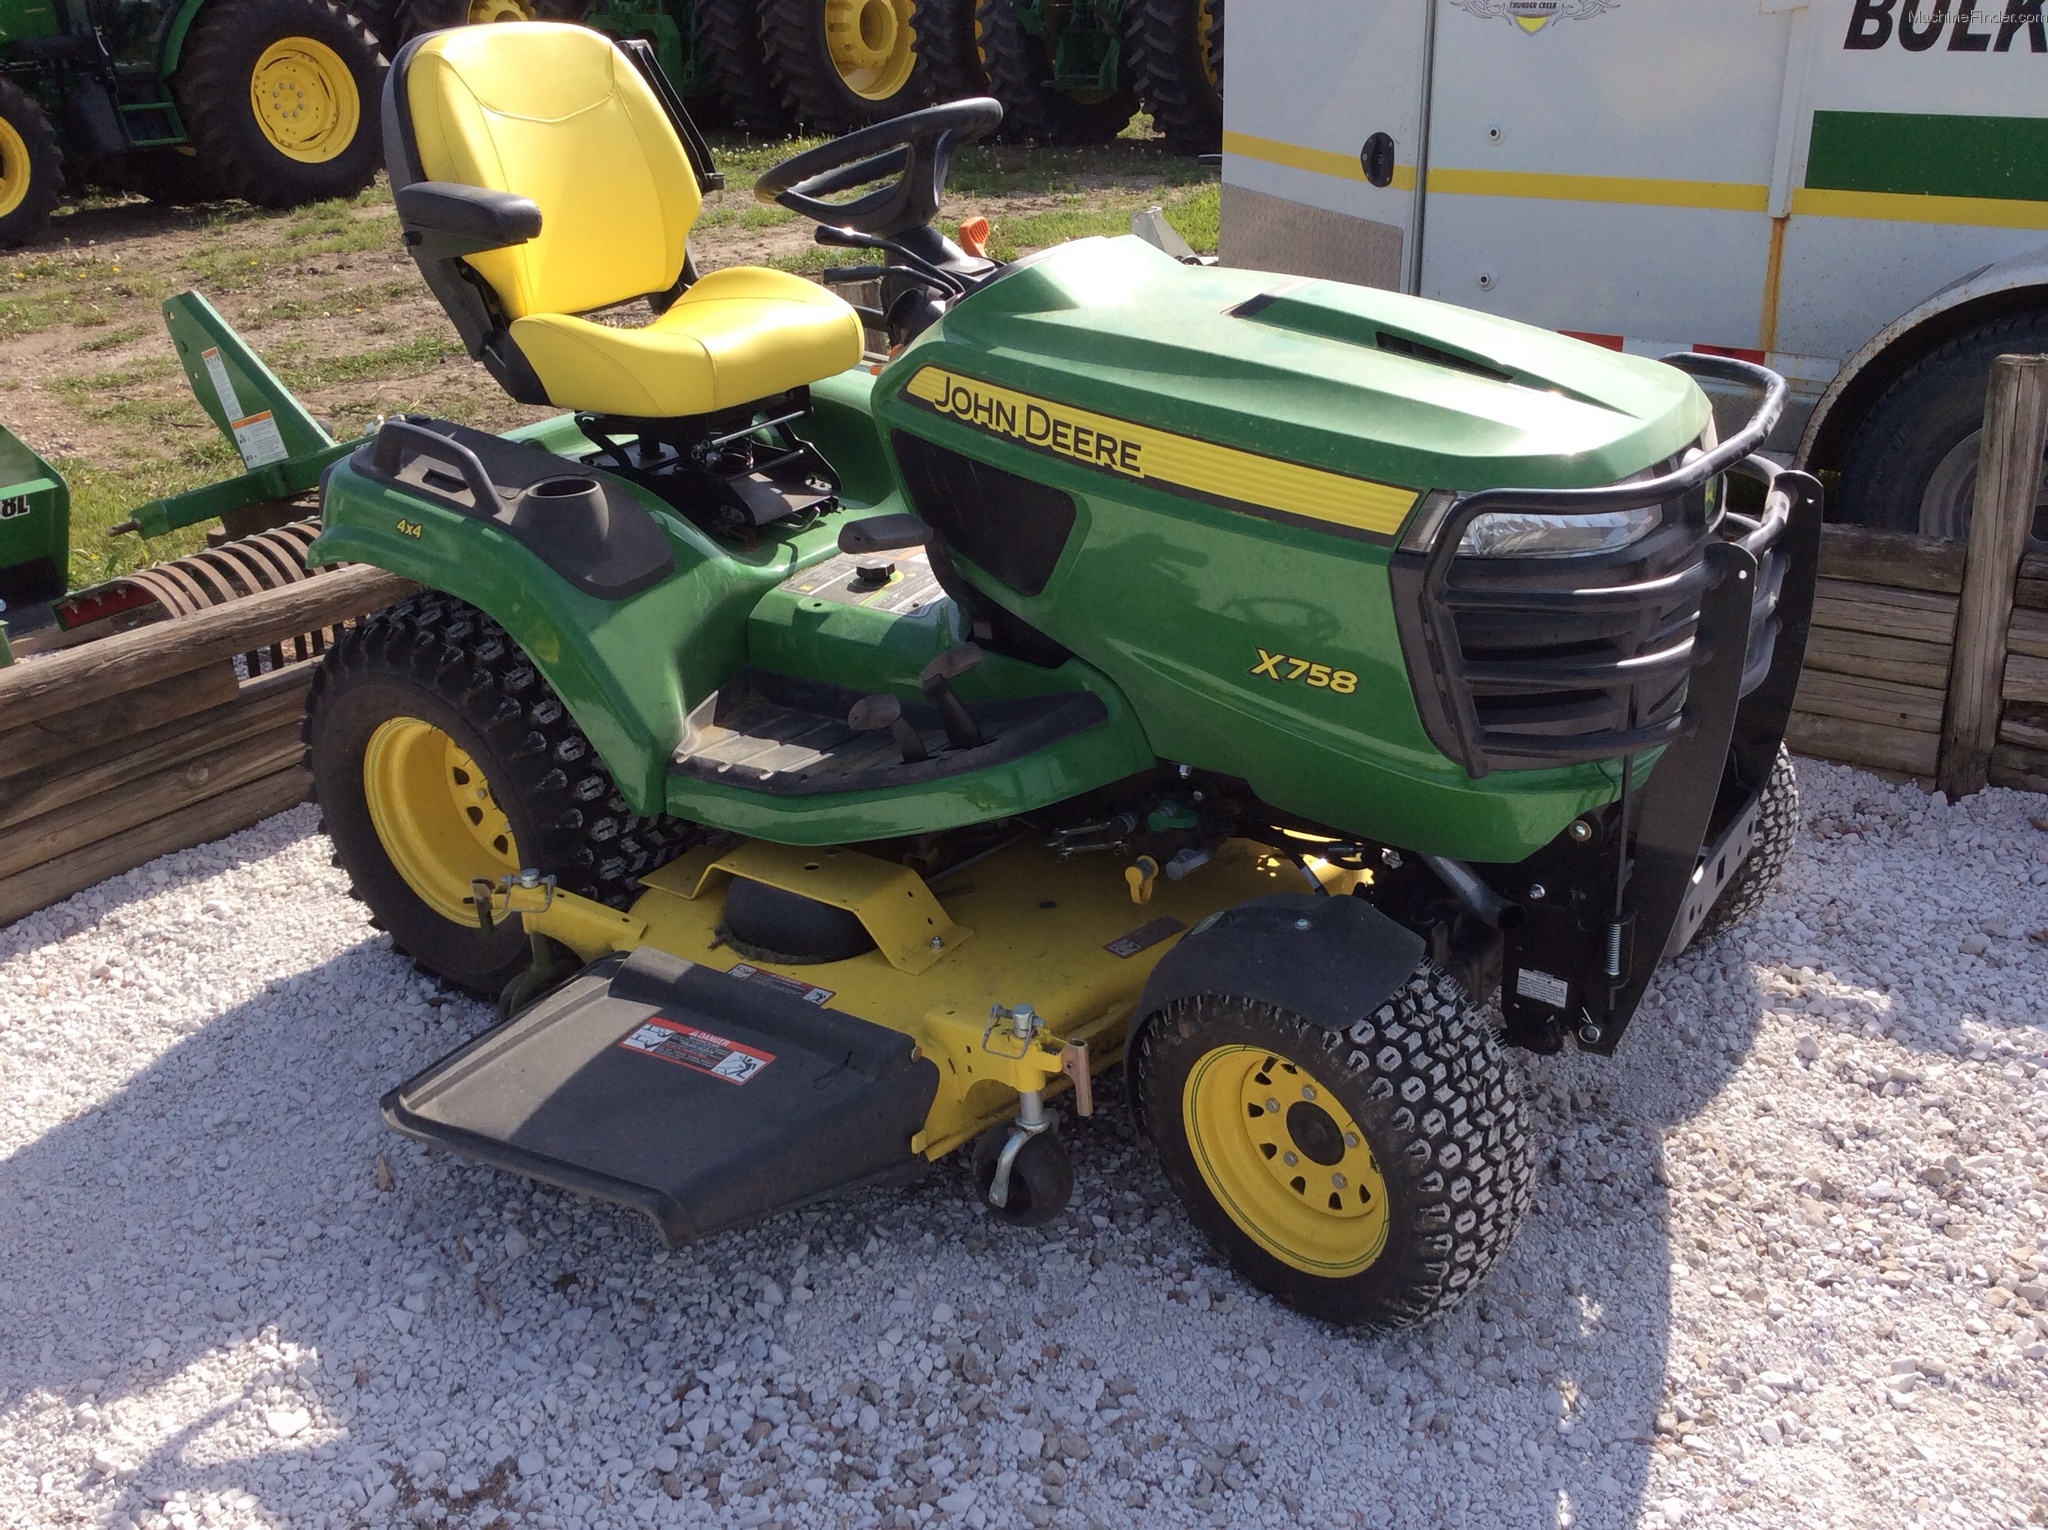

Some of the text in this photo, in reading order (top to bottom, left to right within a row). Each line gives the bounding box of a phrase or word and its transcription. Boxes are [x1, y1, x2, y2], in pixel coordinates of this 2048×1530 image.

[1843, 0, 2048, 52] BULK
[935, 376, 1142, 473] JOHN DEERE
[1248, 647, 1358, 695] X758
[698, 1031, 731, 1047] DANGER
